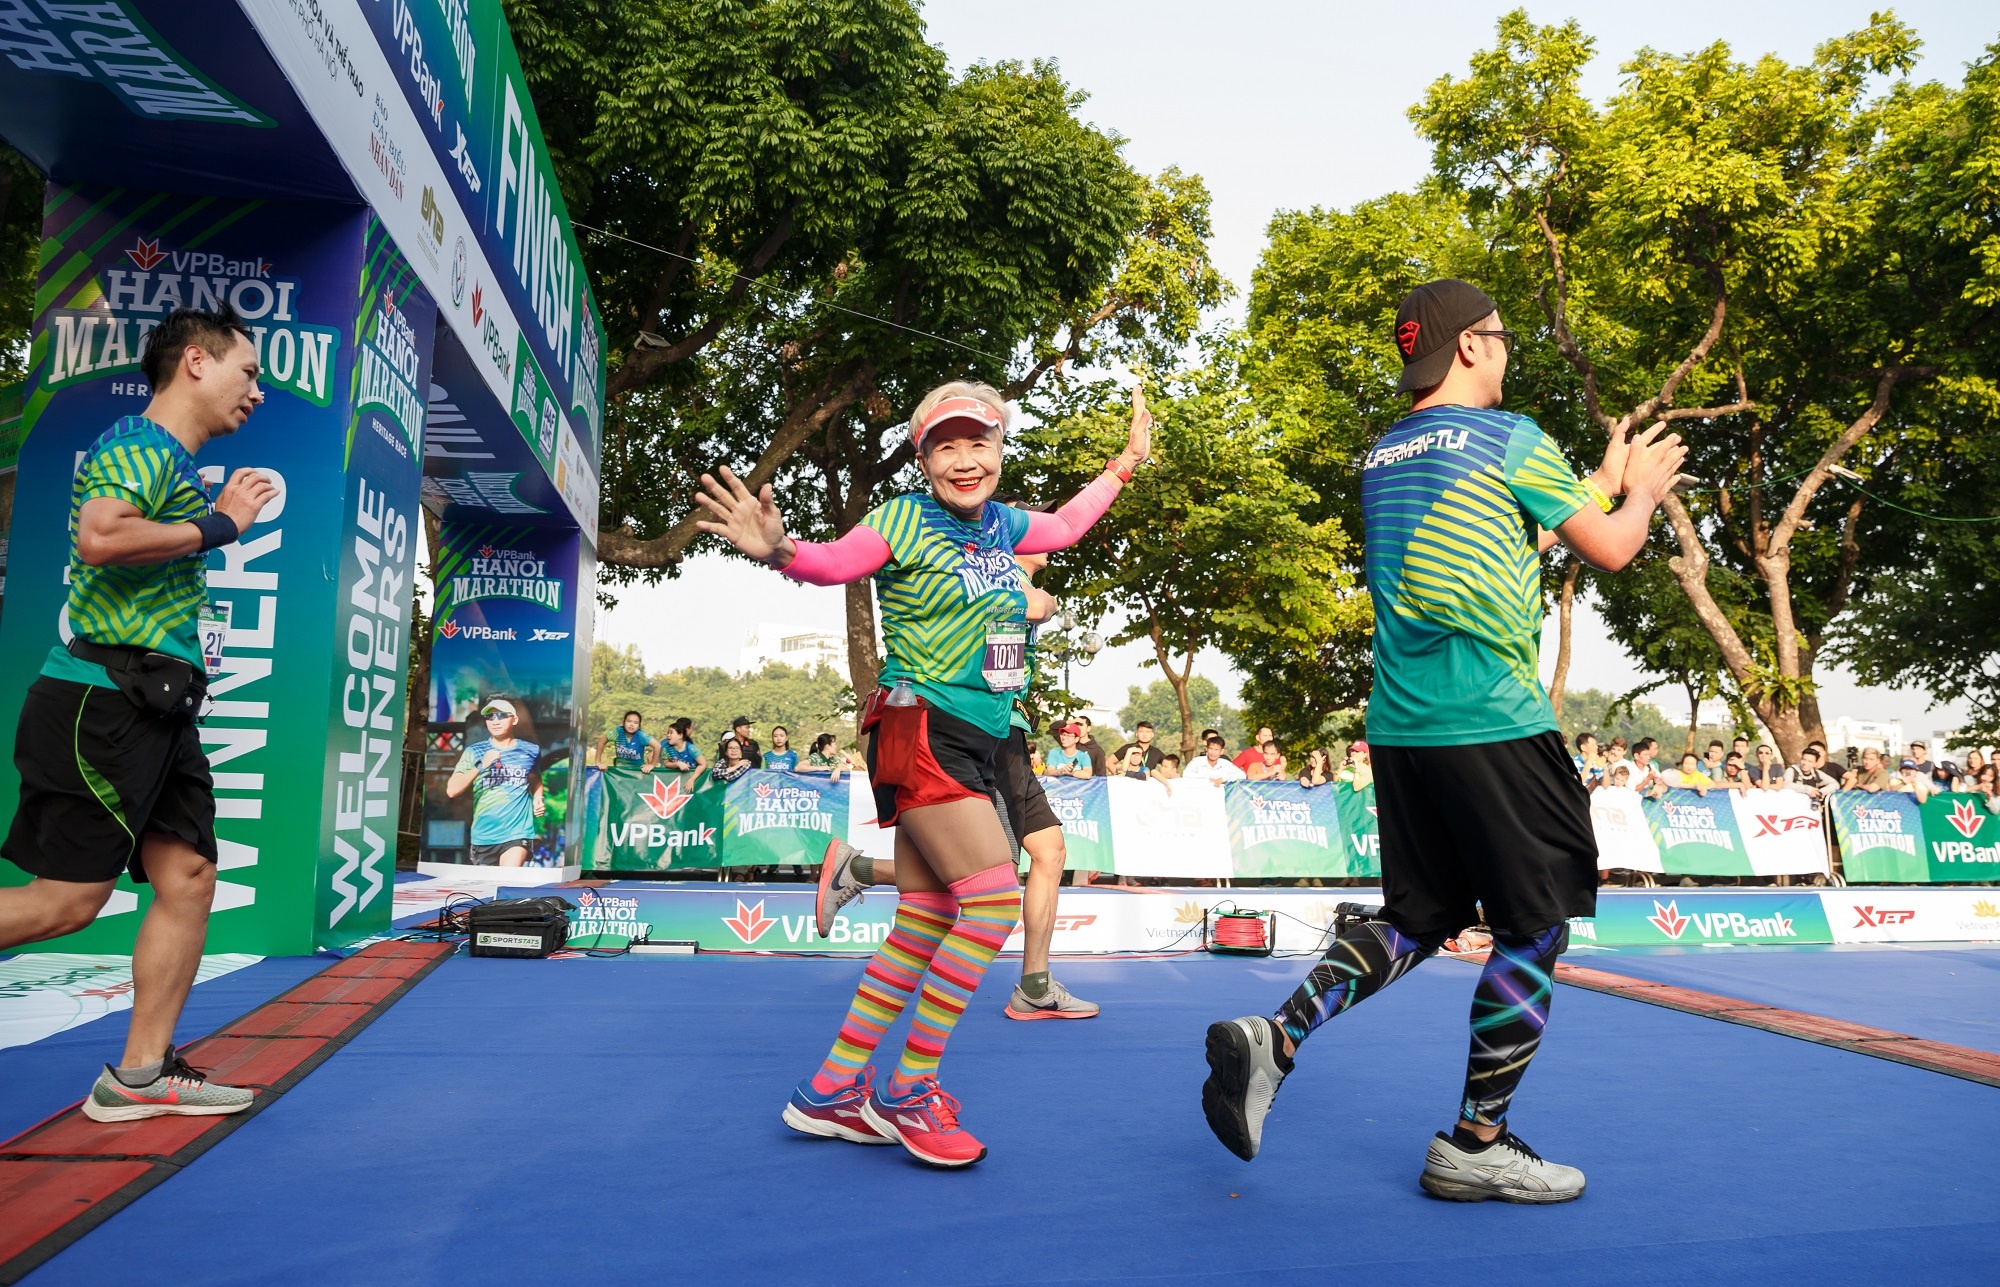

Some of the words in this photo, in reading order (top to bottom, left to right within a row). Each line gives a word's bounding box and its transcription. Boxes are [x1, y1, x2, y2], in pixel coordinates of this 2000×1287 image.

[347, 59, 364, 98] THAO
[393, 0, 444, 133] VPBank
[497, 73, 575, 384] FINISH
[172, 251, 273, 279] VPBank
[104, 269, 295, 322] HANOI
[375, 308, 420, 391] HANOI
[483, 308, 511, 384] VPBank
[357, 343, 424, 463] MARATHON
[495, 549, 536, 560] VPBank
[471, 558, 545, 578] HANOI
[451, 577, 561, 610] MARATHON
[462, 626, 518, 641] VPBank
[526, 628, 570, 642] XTEP
[329, 477, 386, 929] WELCOME
[359, 507, 407, 913] WINNERS
[755, 797, 820, 813] HANOI
[774, 787, 821, 799] VPBank
[1046, 797, 1084, 808] PBank
[1253, 809, 1313, 824] HANOI
[1267, 800, 1311, 811] VPBank
[1677, 805, 1714, 816] VPBank
[738, 812, 833, 837] MARATHON
[1666, 813, 1716, 829] HANOI
[1856, 818, 1903, 833] HANOI
[610, 822, 717, 847] VPBank
[1241, 824, 1329, 850] MARATHON
[1659, 828, 1735, 852] MARATHON
[1848, 833, 1917, 857] MARATHON
[578, 906, 637, 920] HANOI
[1691, 911, 1798, 938] VPBank
[1852, 905, 1916, 929] XTEP
[492, 936, 540, 946] SPORTSTATS
[565, 920, 649, 940] MARATHON
